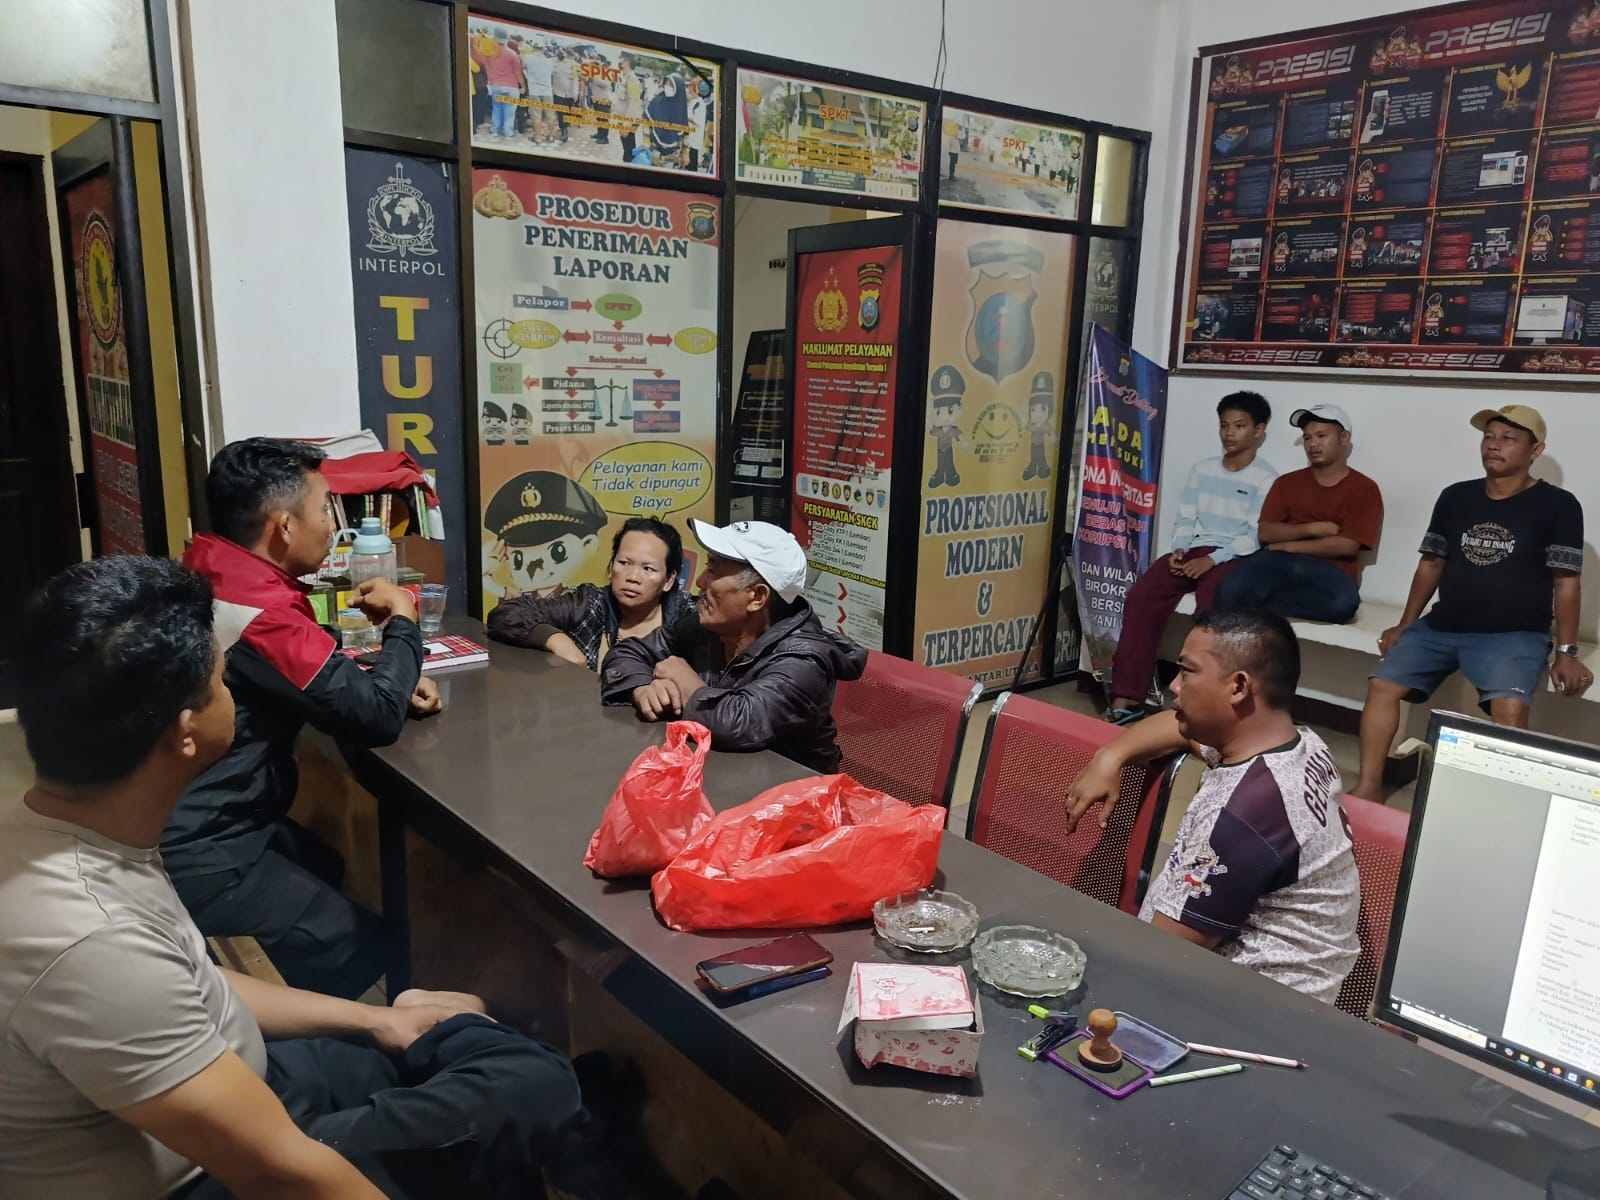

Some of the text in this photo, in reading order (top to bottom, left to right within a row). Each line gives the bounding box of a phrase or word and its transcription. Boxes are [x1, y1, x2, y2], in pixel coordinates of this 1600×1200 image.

[1424, 13, 1552, 51] PRESISI
[1255, 46, 1356, 79] PRESISI
[580, 62, 622, 83] SPKT
[819, 105, 851, 121] SPKT
[1002, 137, 1027, 150] SPKT
[537, 194, 672, 230] PROSEDUR
[524, 225, 689, 259] PENERIMAAN
[359, 257, 446, 276] INTERPOL
[553, 256, 671, 284] LAPORAN
[516, 296, 566, 308] Pelapor
[594, 333, 641, 344] Konsultasi
[802, 343, 893, 358] MAKLUMAT PELAYANAN
[1228, 349, 1323, 362] PRESISI
[1387, 351, 1505, 367] PRESISI
[552, 379, 586, 389] Pidana
[545, 424, 571, 434] Proses
[593, 459, 704, 476] Pelayanan kami
[592, 476, 700, 492] Tidak dipungut
[632, 495, 672, 510] Biaya
[1082, 496, 1121, 515] ENUJU
[803, 502, 879, 531] PERSYARATAN SKCK
[925, 490, 1048, 535] PROFESIONAL
[945, 535, 1024, 577] MODERN
[1082, 562, 1100, 577] DAN
[1085, 579, 1127, 599] BIROKR
[977, 580, 993, 616] &
[1091, 597, 1125, 613] BERSI
